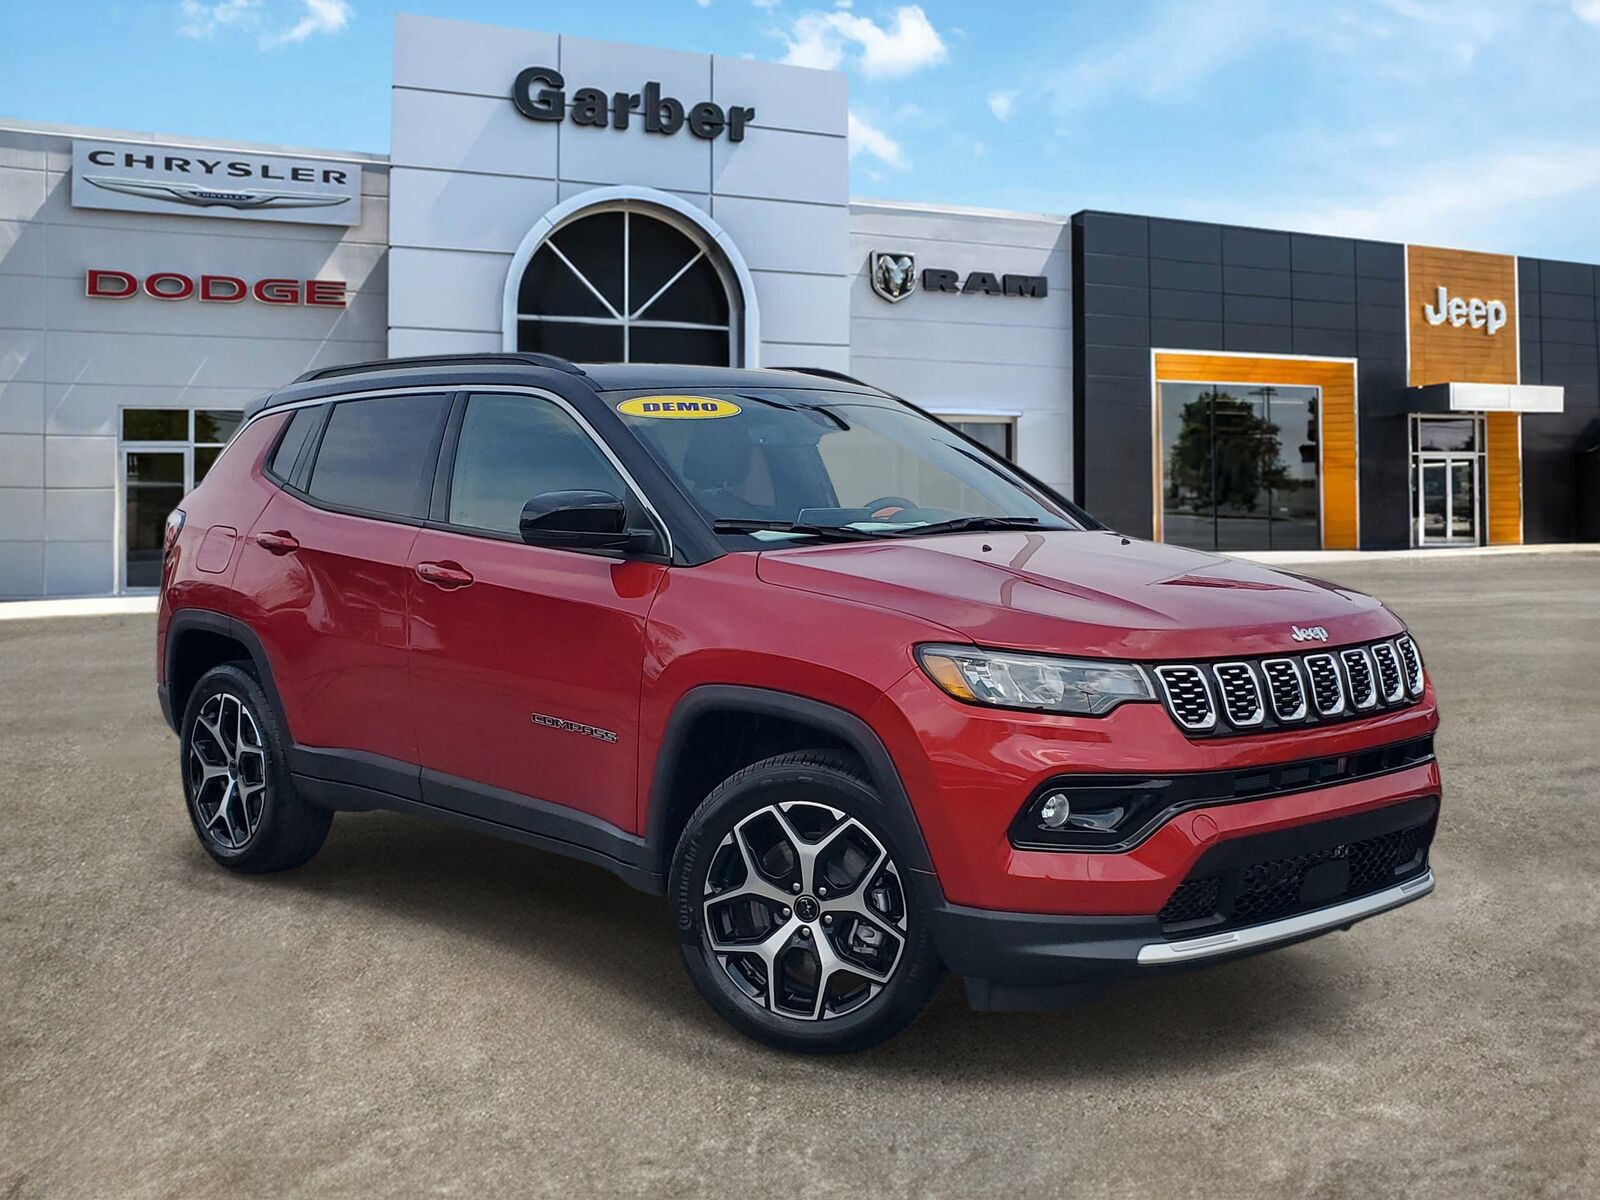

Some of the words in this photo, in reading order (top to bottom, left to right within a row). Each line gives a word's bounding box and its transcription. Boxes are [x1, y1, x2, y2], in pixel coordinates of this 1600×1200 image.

[512, 66, 755, 142] Garber
[88, 150, 347, 185] CHRYSLER
[85, 268, 348, 309] DODGE
[921, 267, 1049, 299] RAM
[1423, 285, 1508, 336] Jeep
[642, 402, 719, 412] DEMO
[1291, 625, 1329, 643] Jeep
[531, 712, 618, 744] COMPASS
